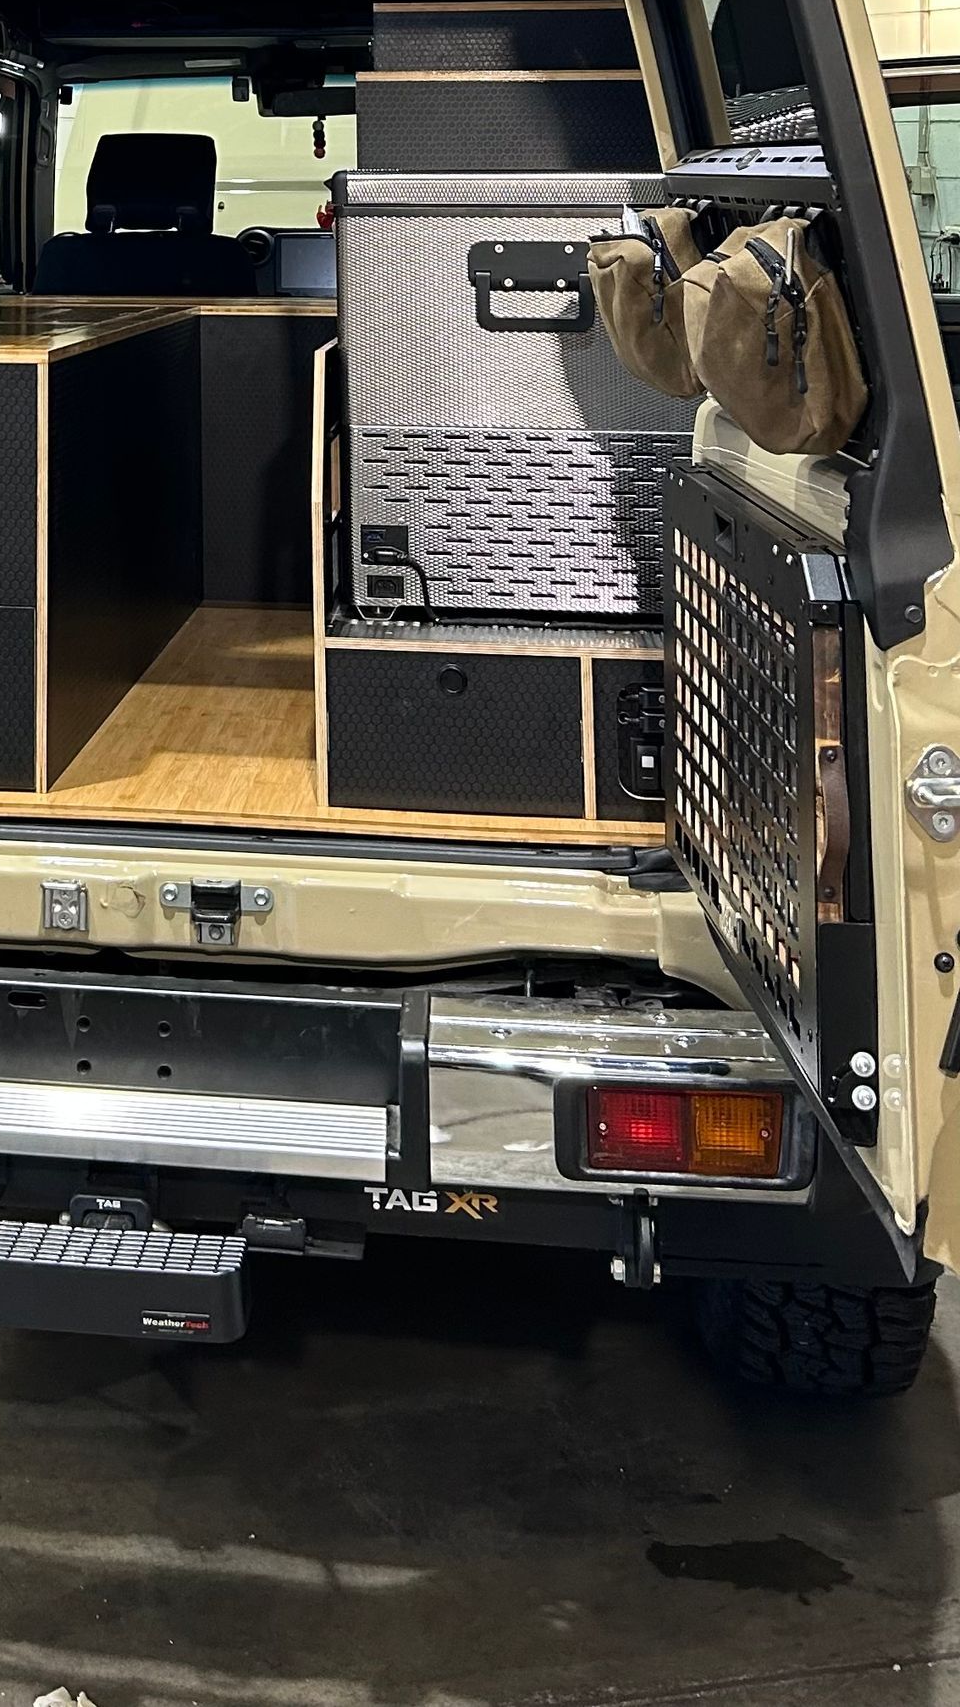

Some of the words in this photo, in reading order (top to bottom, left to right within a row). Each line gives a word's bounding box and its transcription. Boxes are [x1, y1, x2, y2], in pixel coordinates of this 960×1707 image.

[96, 1198, 121, 1210] TAG
[364, 1187, 438, 1213] TAG
[444, 1190, 499, 1220] XR
[142, 1317, 209, 1330] WeatherTech
